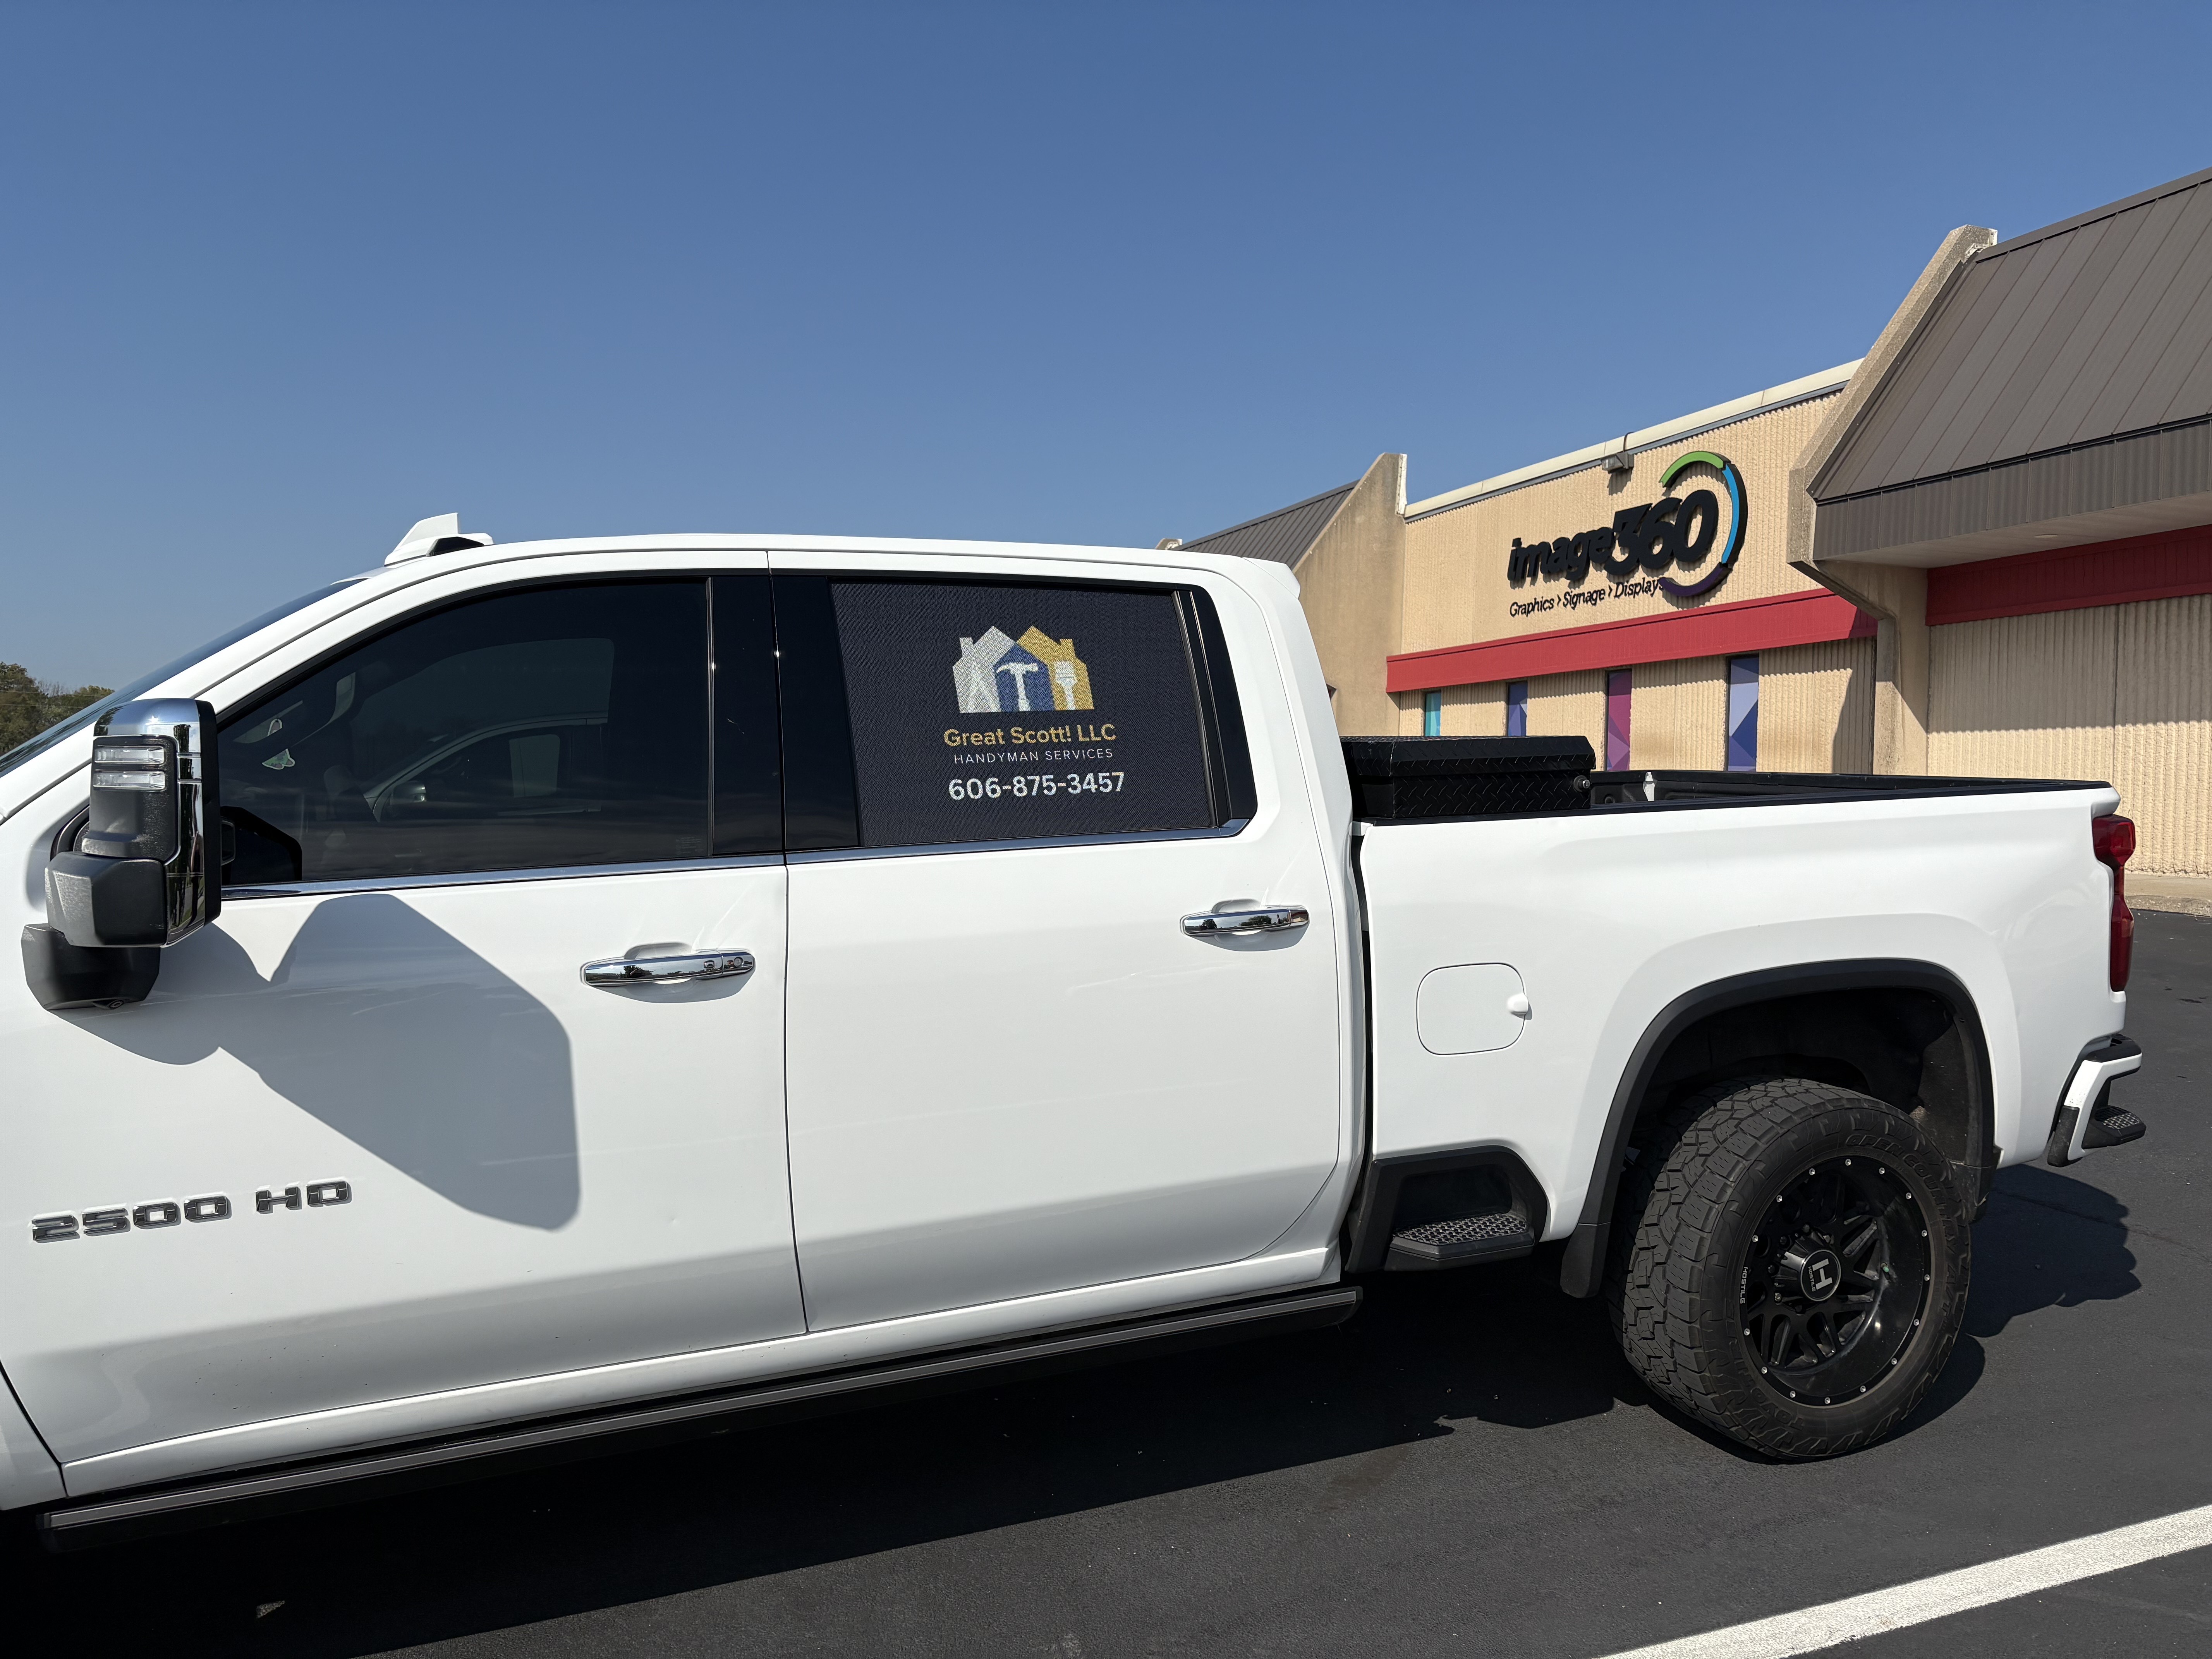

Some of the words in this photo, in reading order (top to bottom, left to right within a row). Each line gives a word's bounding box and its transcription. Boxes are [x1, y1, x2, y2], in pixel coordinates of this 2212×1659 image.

[1507, 489, 1719, 581] image360
[1510, 597, 1554, 617] Graphics
[1563, 583, 1606, 610] Signage
[944, 728, 1005, 747] Great
[1010, 725, 1072, 744] Scott!
[1077, 724, 1117, 741] LLC
[954, 750, 1039, 764] HANDYMAN
[1045, 749, 1113, 761] SERVICES
[948, 772, 1125, 800] 606-875-3457
[1845, 1134, 1904, 1157] OPEN
[31, 1196, 229, 1242] 2500
[256, 1180, 350, 1213] HD
[1740, 1266, 1748, 1304] HOSTILE
[1752, 1388, 1804, 1430] TOYO
